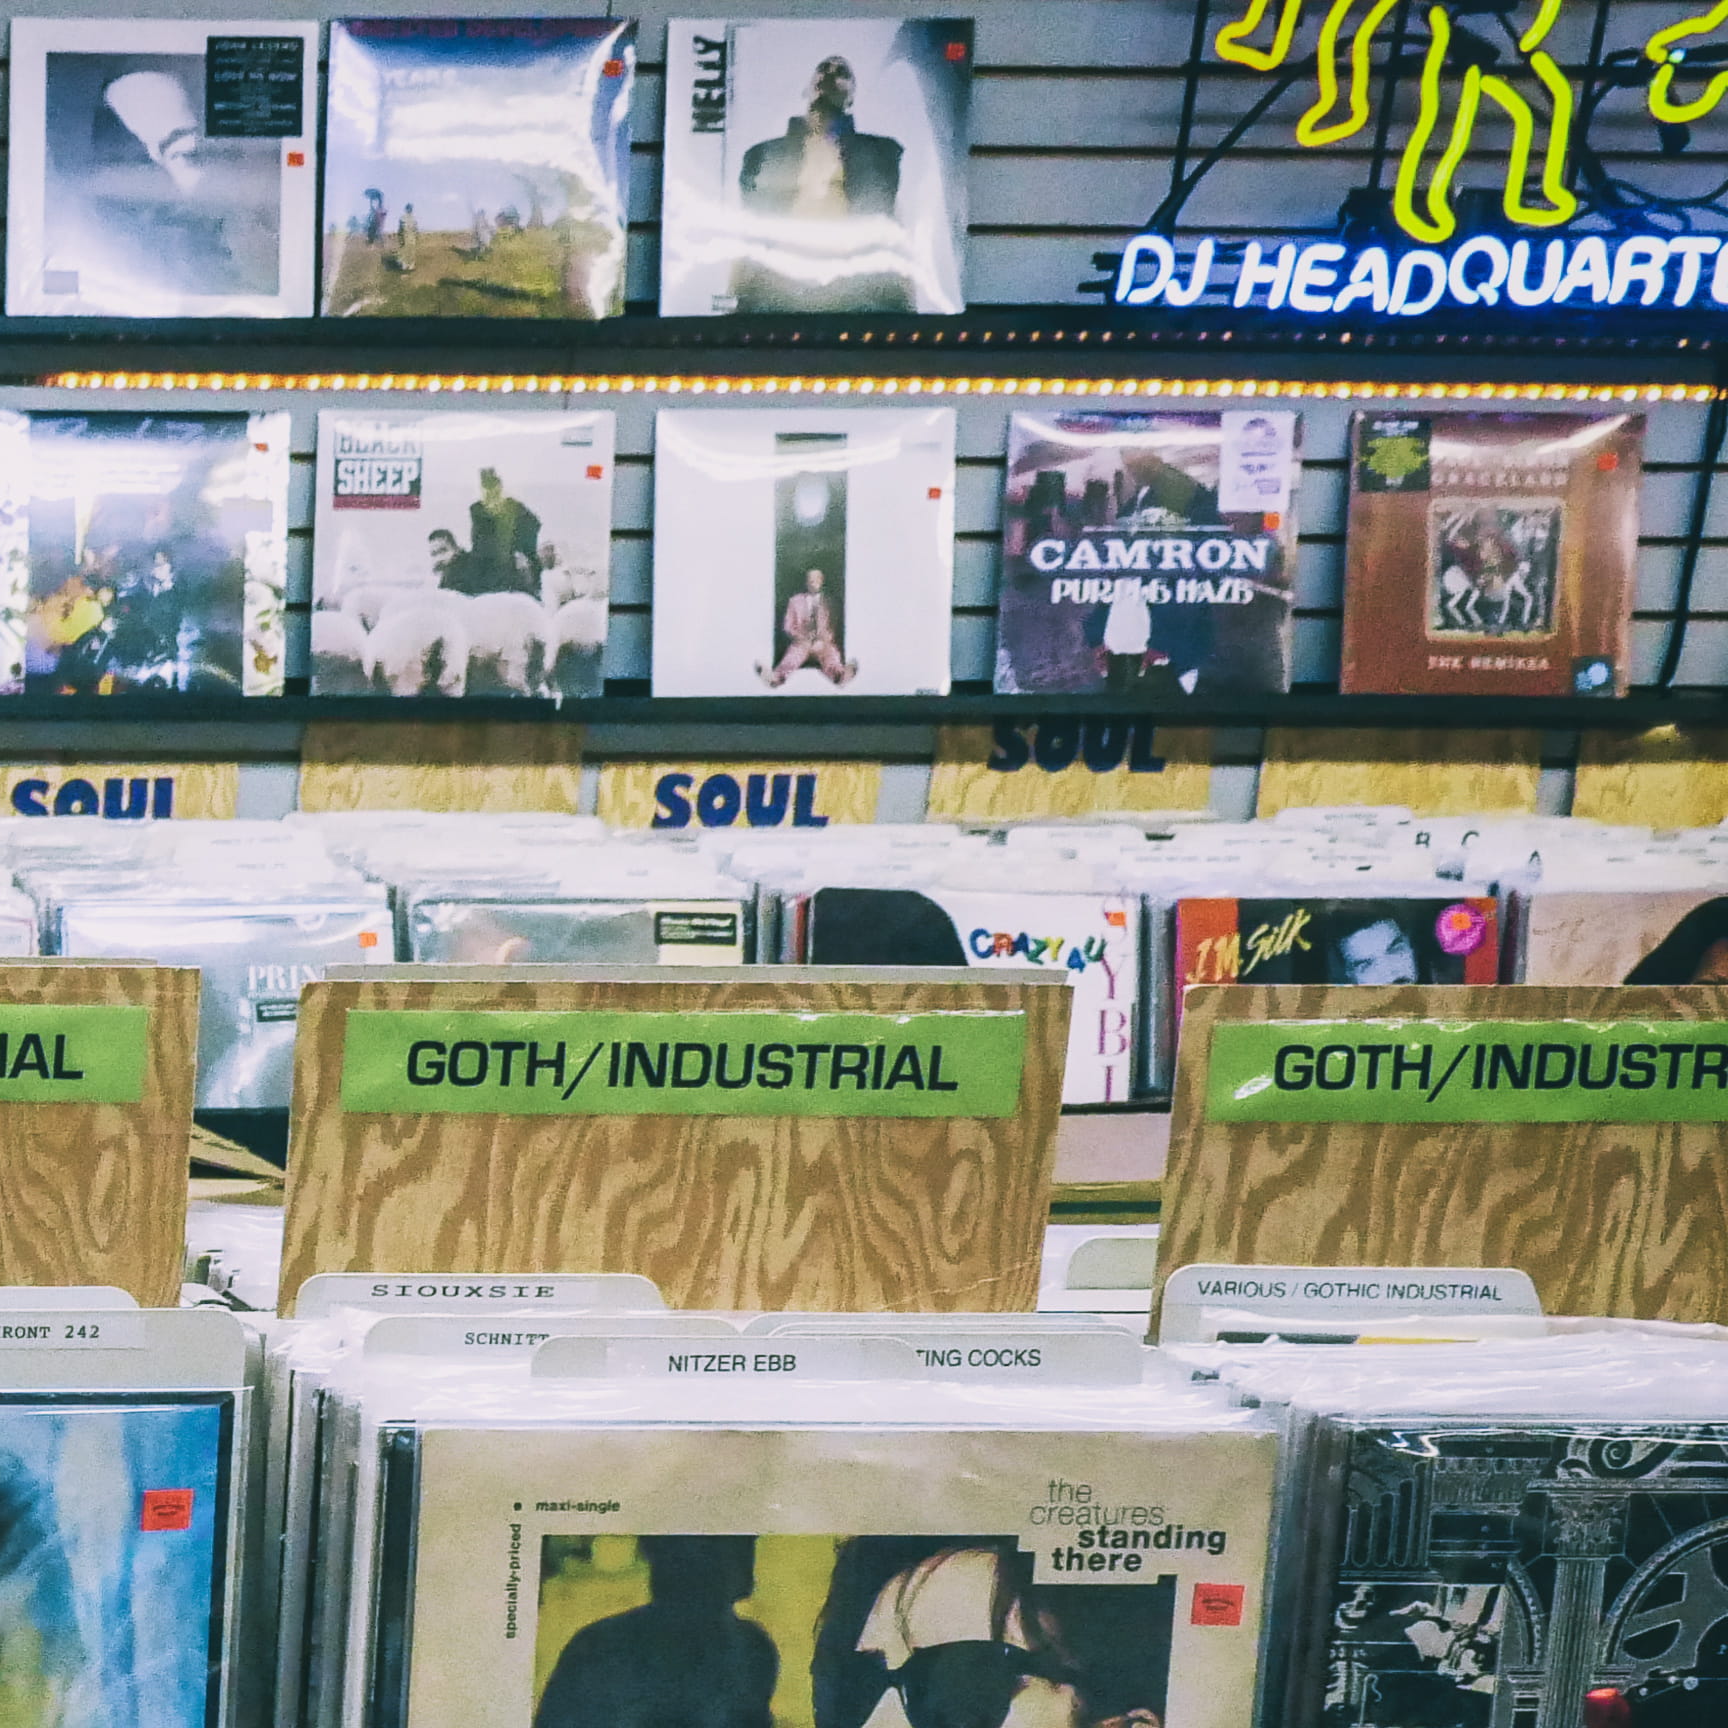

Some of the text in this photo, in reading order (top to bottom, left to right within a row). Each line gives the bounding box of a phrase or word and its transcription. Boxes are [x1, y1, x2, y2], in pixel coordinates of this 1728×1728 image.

[689, 33, 728, 136] NELLY
[1115, 234, 1214, 304] DJ
[336, 460, 420, 496] SHEEP
[1030, 537, 1270, 572] CAM'RON
[987, 716, 1166, 774] SOUL
[651, 772, 829, 830] SOUL
[968, 927, 1065, 966] CRAZY
[406, 1040, 960, 1101] GOTH/INDUSTRIAL
[1273, 1043, 1728, 1103] GOTH/INDUSTR
[371, 1284, 555, 1298] SIOUXSIE
[1196, 1280, 1504, 1303] VARIOUS GOTHIC INDUSTRIAL
[64, 1324, 100, 1339] 242
[668, 1354, 797, 1373] NITZER EBB
[967, 1347, 1042, 1368] COCKS
[534, 1498, 621, 1516] maxi-single
[1046, 1477, 1094, 1505] the
[1029, 1499, 1166, 1525] creatures
[1078, 1523, 1228, 1556] standing
[1051, 1548, 1144, 1574] there
[505, 1523, 524, 1640] specially-priced
